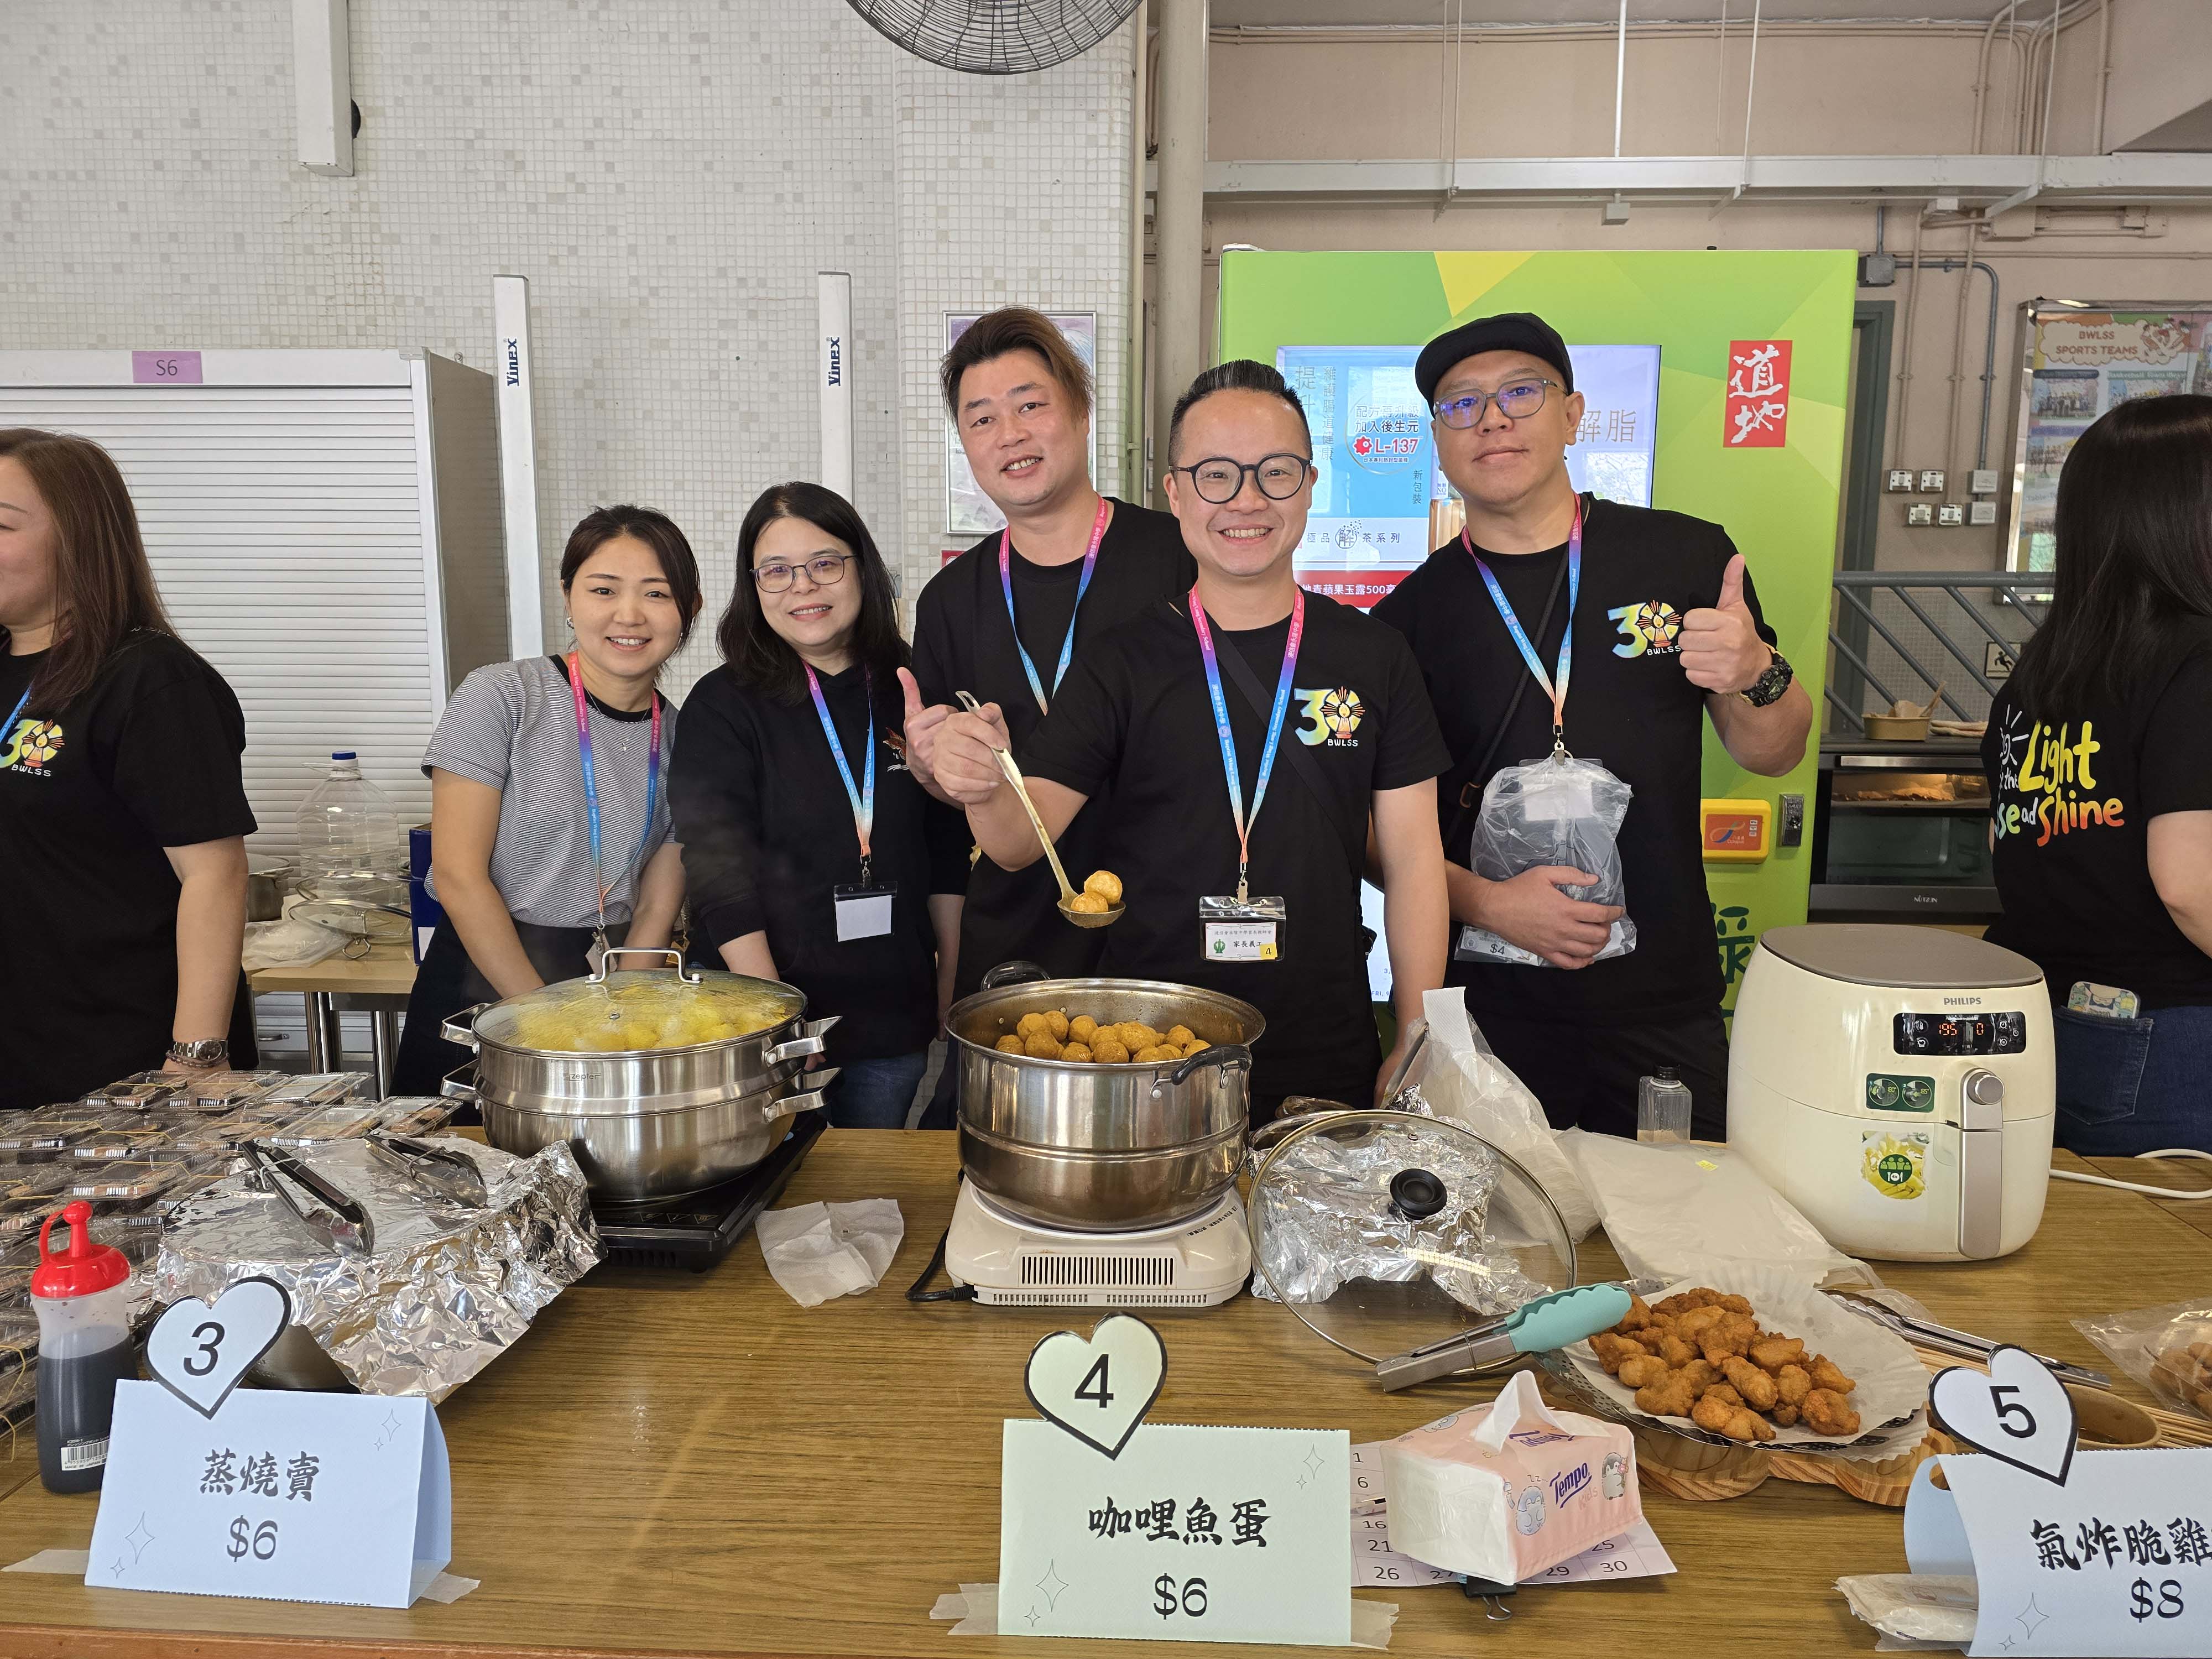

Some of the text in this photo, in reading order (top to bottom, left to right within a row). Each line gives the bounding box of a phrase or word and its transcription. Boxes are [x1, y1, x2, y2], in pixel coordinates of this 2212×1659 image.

[506, 338, 520, 387] Vinex
[828, 337, 841, 387] Vinex
[2056, 346, 2138, 354] SPORTS TEAMS
[155, 359, 178, 377] S6
[1729, 344, 1786, 444] 道地
[1355, 405, 1420, 418] 配方再升級
[1355, 420, 1419, 433] 加入後生元
[1375, 439, 1418, 453] L-137
[1412, 469, 1423, 504] 新包裝
[1647, 645, 1682, 656] BWLSS
[1327, 739, 1358, 747] BWLSS
[2019, 719, 2100, 794] Light
[11, 764, 51, 777] BWLSS
[2037, 787, 2125, 847] Shine
[1265, 947, 1272, 956] 4
[1490, 943, 1505, 955] $4
[1943, 997, 1981, 1005] PHILIPS
[1939, 1023, 1957, 1036] 195
[183, 1321, 225, 1376] 3
[1074, 1354, 1114, 1408] 4
[1989, 1385, 2037, 1438] 5
[1353, 1453, 1364, 1464] 1
[199, 1449, 320, 1504] 蒸燒賣
[1357, 1476, 1369, 1489] 6
[1549, 1462, 1591, 1506] Tempo
[1088, 1496, 1272, 1547] 咖哩魚蛋
[227, 1516, 278, 1562] $6
[1368, 1539, 1394, 1553] 21
[2030, 1517, 2212, 1570] 氣炸脆雞
[1375, 1566, 1400, 1581] 26
[1546, 1565, 1570, 1577] 29
[1599, 1559, 1627, 1573] 30
[1153, 1572, 1208, 1620] $6
[2130, 1577, 2184, 1623] $8
